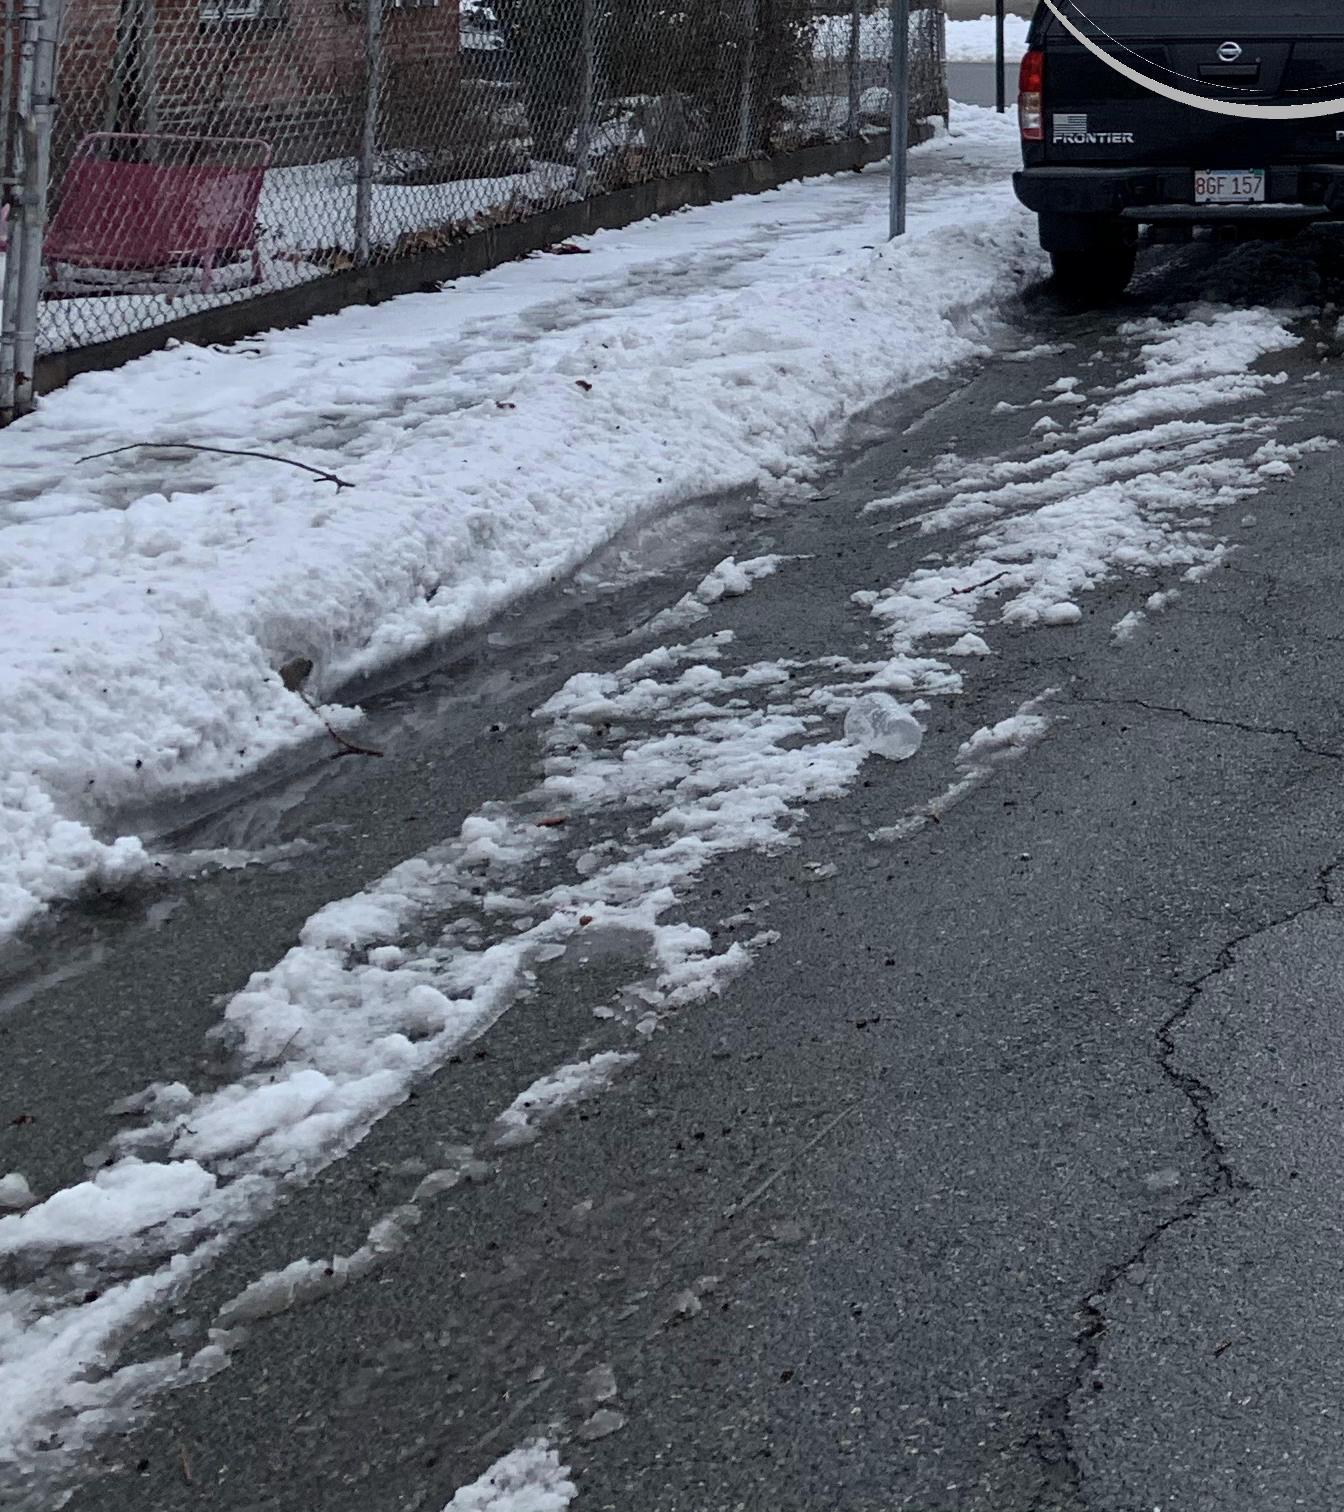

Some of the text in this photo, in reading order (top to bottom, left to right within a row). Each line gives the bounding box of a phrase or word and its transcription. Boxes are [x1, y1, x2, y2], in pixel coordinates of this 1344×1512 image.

[1052, 131, 1135, 144] FRONTIER
[1196, 176, 1263, 195] 8GF 157
